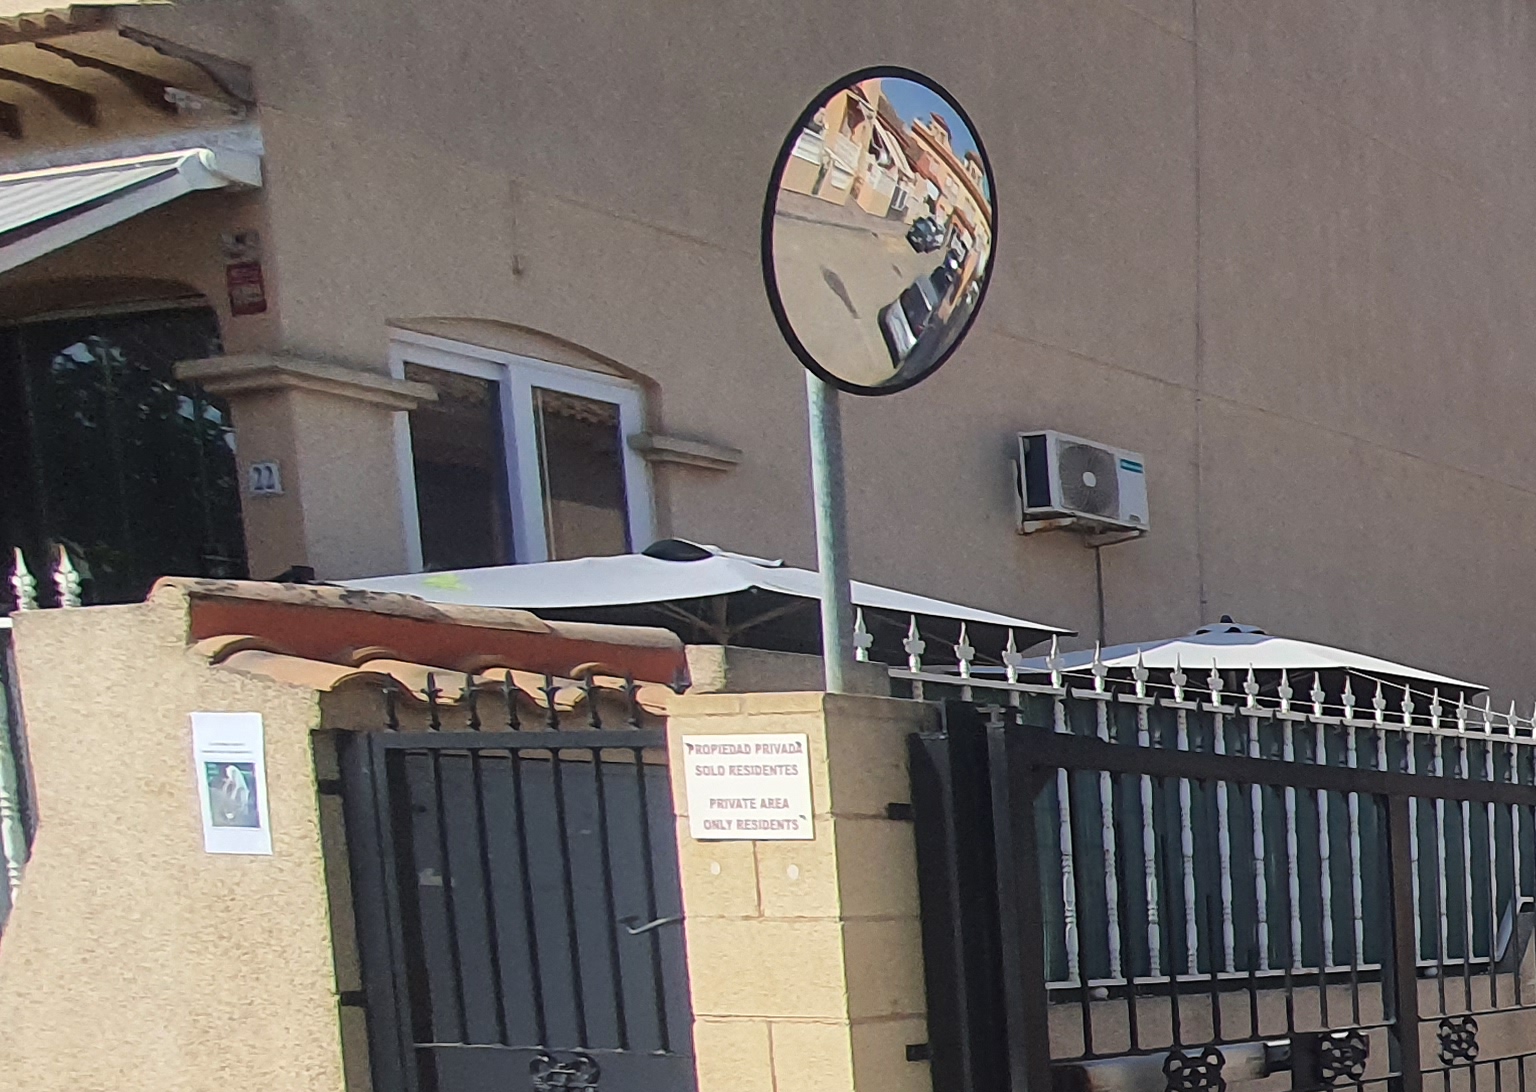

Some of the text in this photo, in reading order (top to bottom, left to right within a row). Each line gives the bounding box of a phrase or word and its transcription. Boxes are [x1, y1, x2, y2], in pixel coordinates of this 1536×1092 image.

[687, 742, 803, 755] PROPIEDAD PRIVADA
[694, 764, 799, 776] SOLO RESIDENTES
[709, 798, 789, 810] PRIVATE AREA
[703, 819, 799, 830] ONLY RESIDENTS
